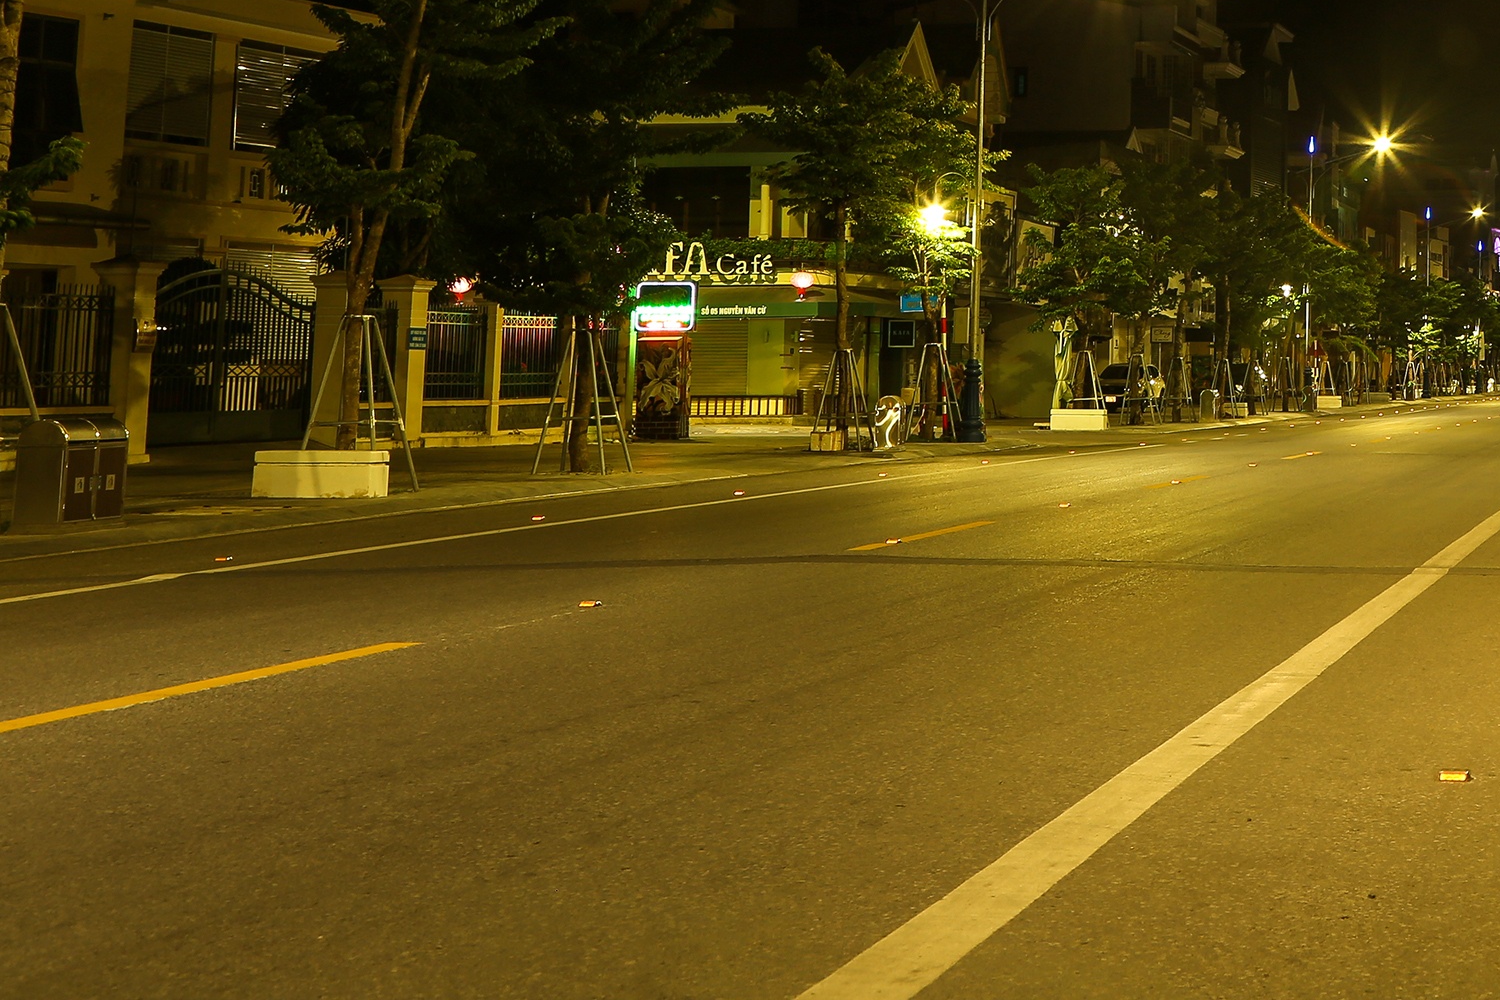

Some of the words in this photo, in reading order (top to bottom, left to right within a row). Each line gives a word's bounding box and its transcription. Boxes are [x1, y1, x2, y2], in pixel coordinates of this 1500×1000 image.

[716, 253, 773, 274] Café
[701, 304, 709, 315] SỐ
[719, 304, 743, 315] NGUYỄN
[744, 305, 756, 315] VĂN
